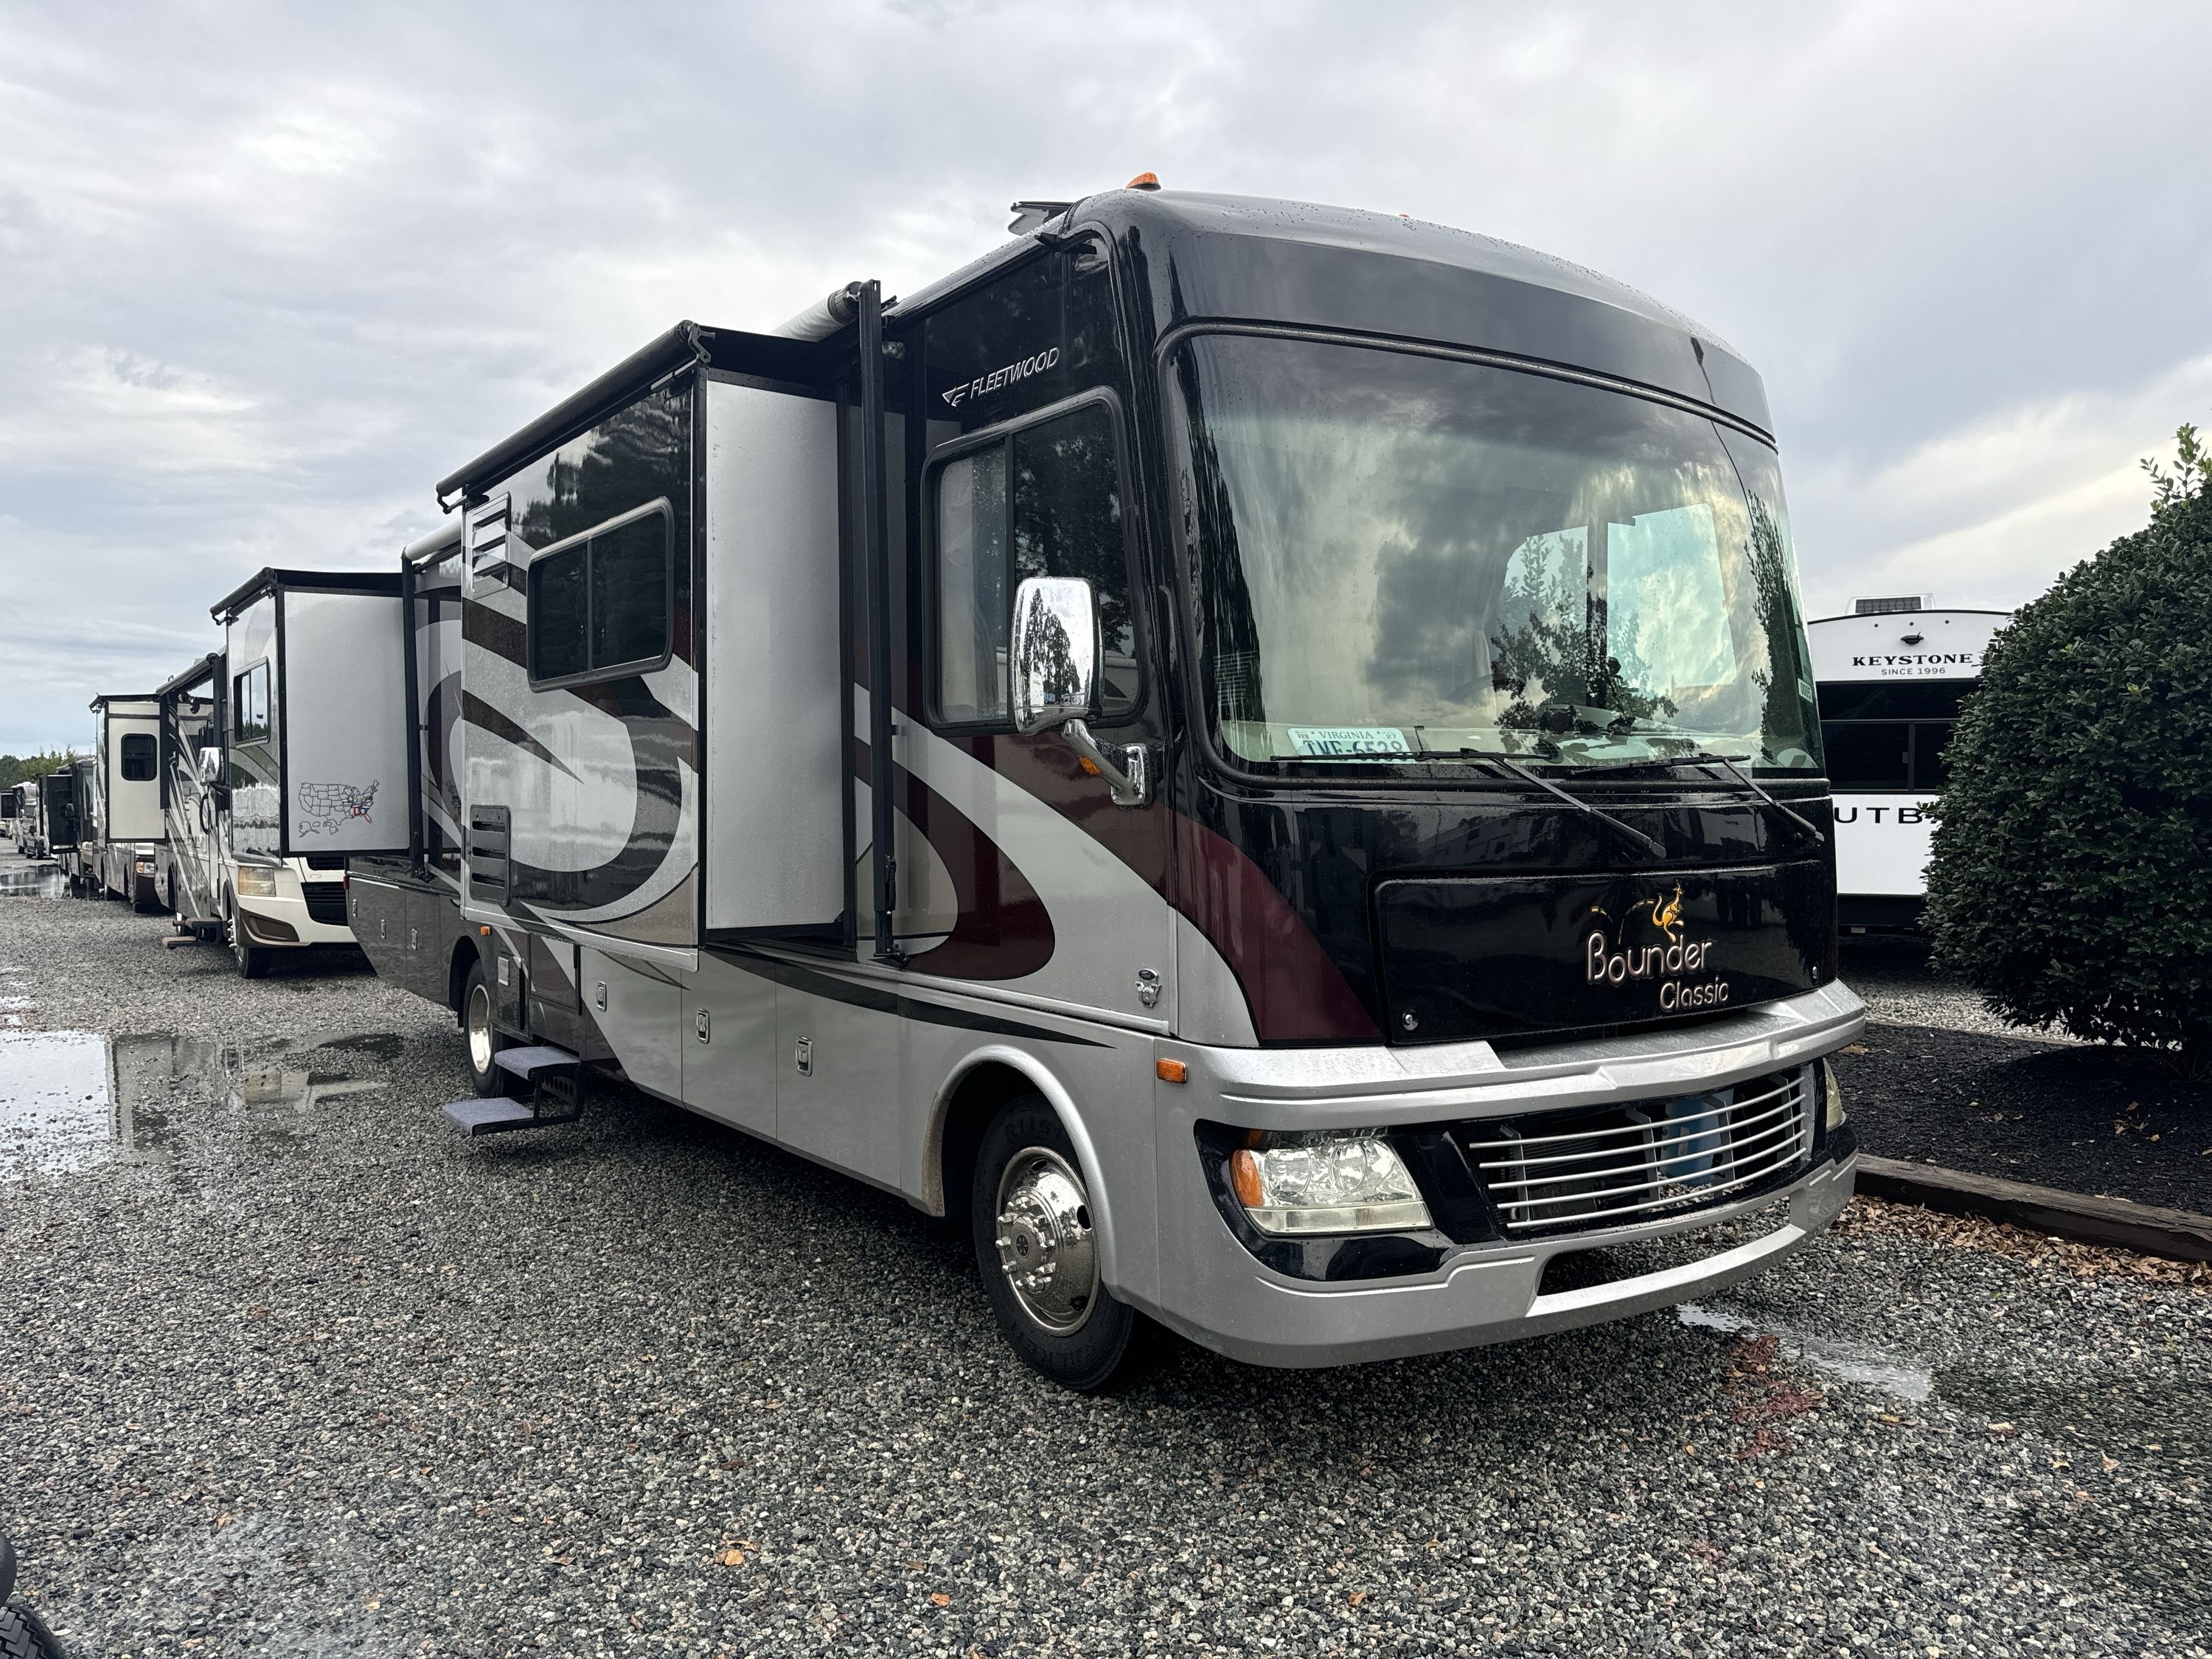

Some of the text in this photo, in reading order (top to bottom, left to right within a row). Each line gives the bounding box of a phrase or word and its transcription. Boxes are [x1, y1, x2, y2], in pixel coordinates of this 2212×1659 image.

[970, 347, 1060, 400] FLEETWOOD
[1852, 653, 1973, 667] KEYSTONE
[1918, 667, 1947, 675] 1996
[1318, 731, 1374, 739] VIRGINIA
[1834, 807, 1943, 824] UTB
[1587, 931, 1714, 986] Bounder
[1660, 975, 1729, 1012] Classic
